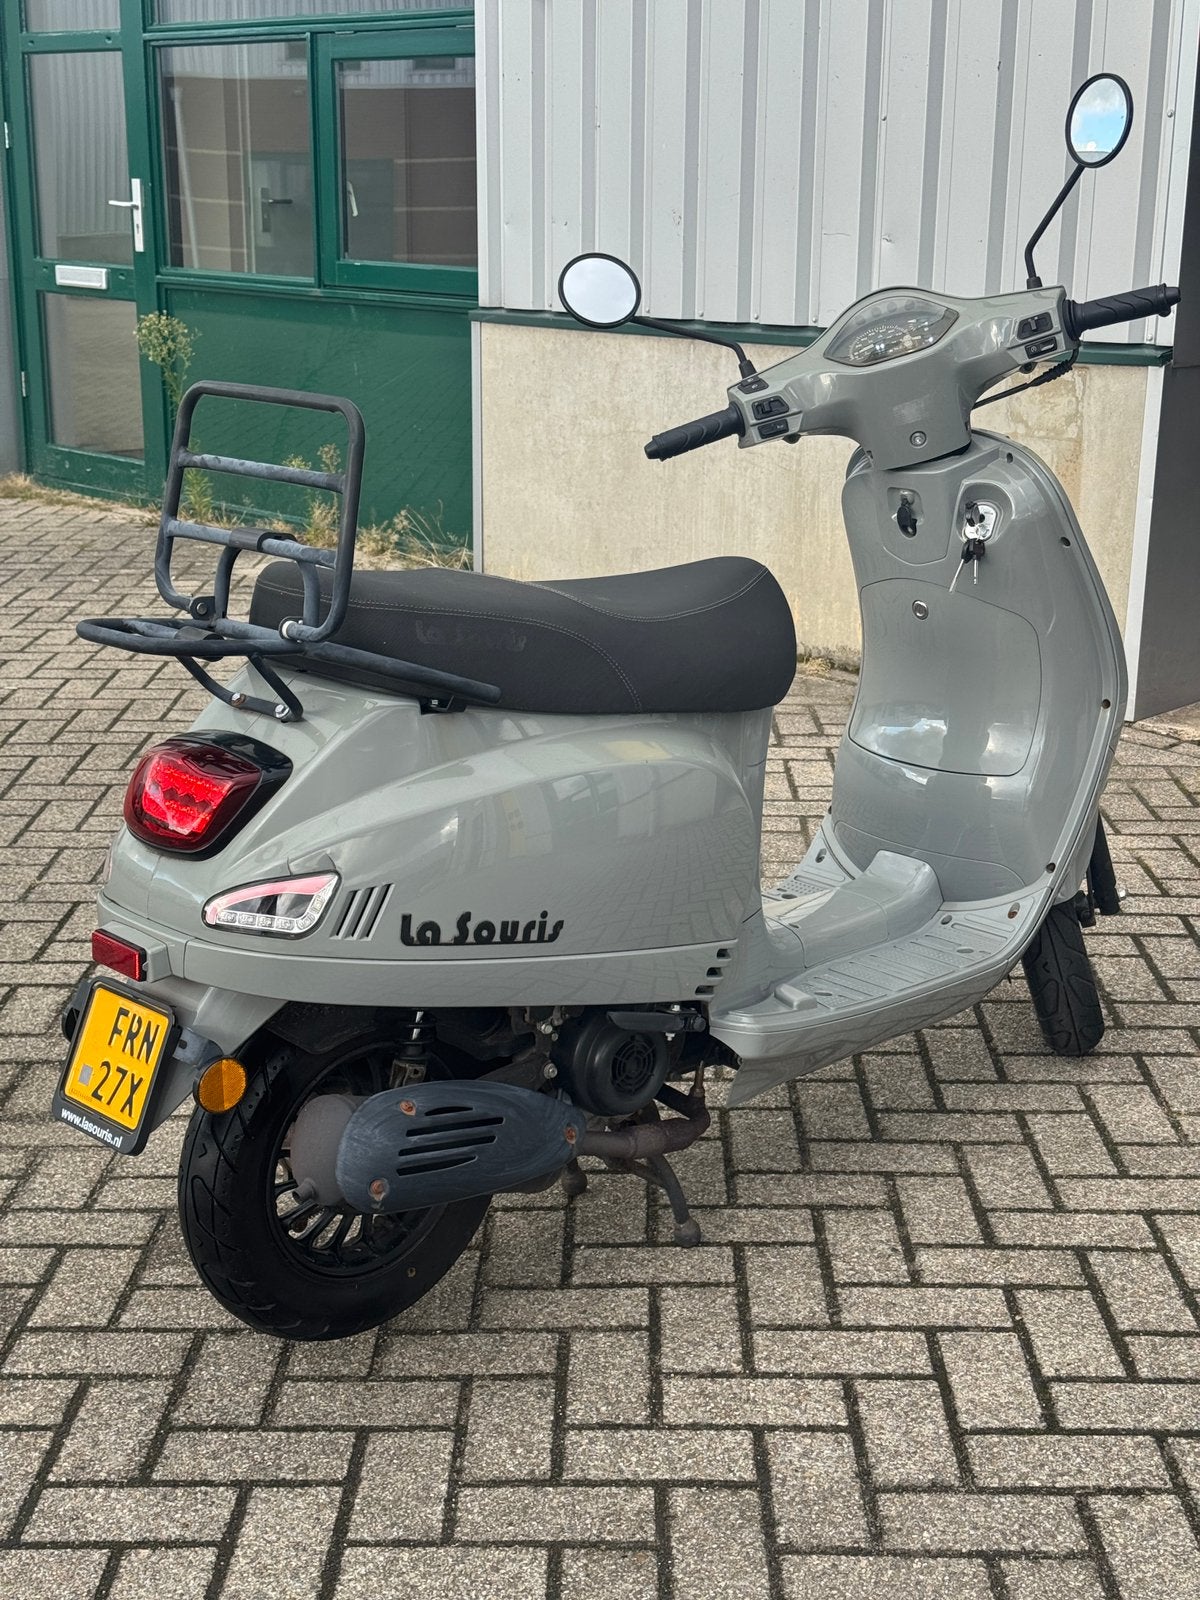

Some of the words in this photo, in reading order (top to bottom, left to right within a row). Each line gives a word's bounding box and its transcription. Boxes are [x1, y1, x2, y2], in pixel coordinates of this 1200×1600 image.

[401, 912, 441, 946] La
[452, 910, 564, 944] Souris
[108, 1006, 160, 1064] FRN
[91, 1060, 143, 1118] 27X
[61, 1108, 123, 1149] www.lasouris.nl
